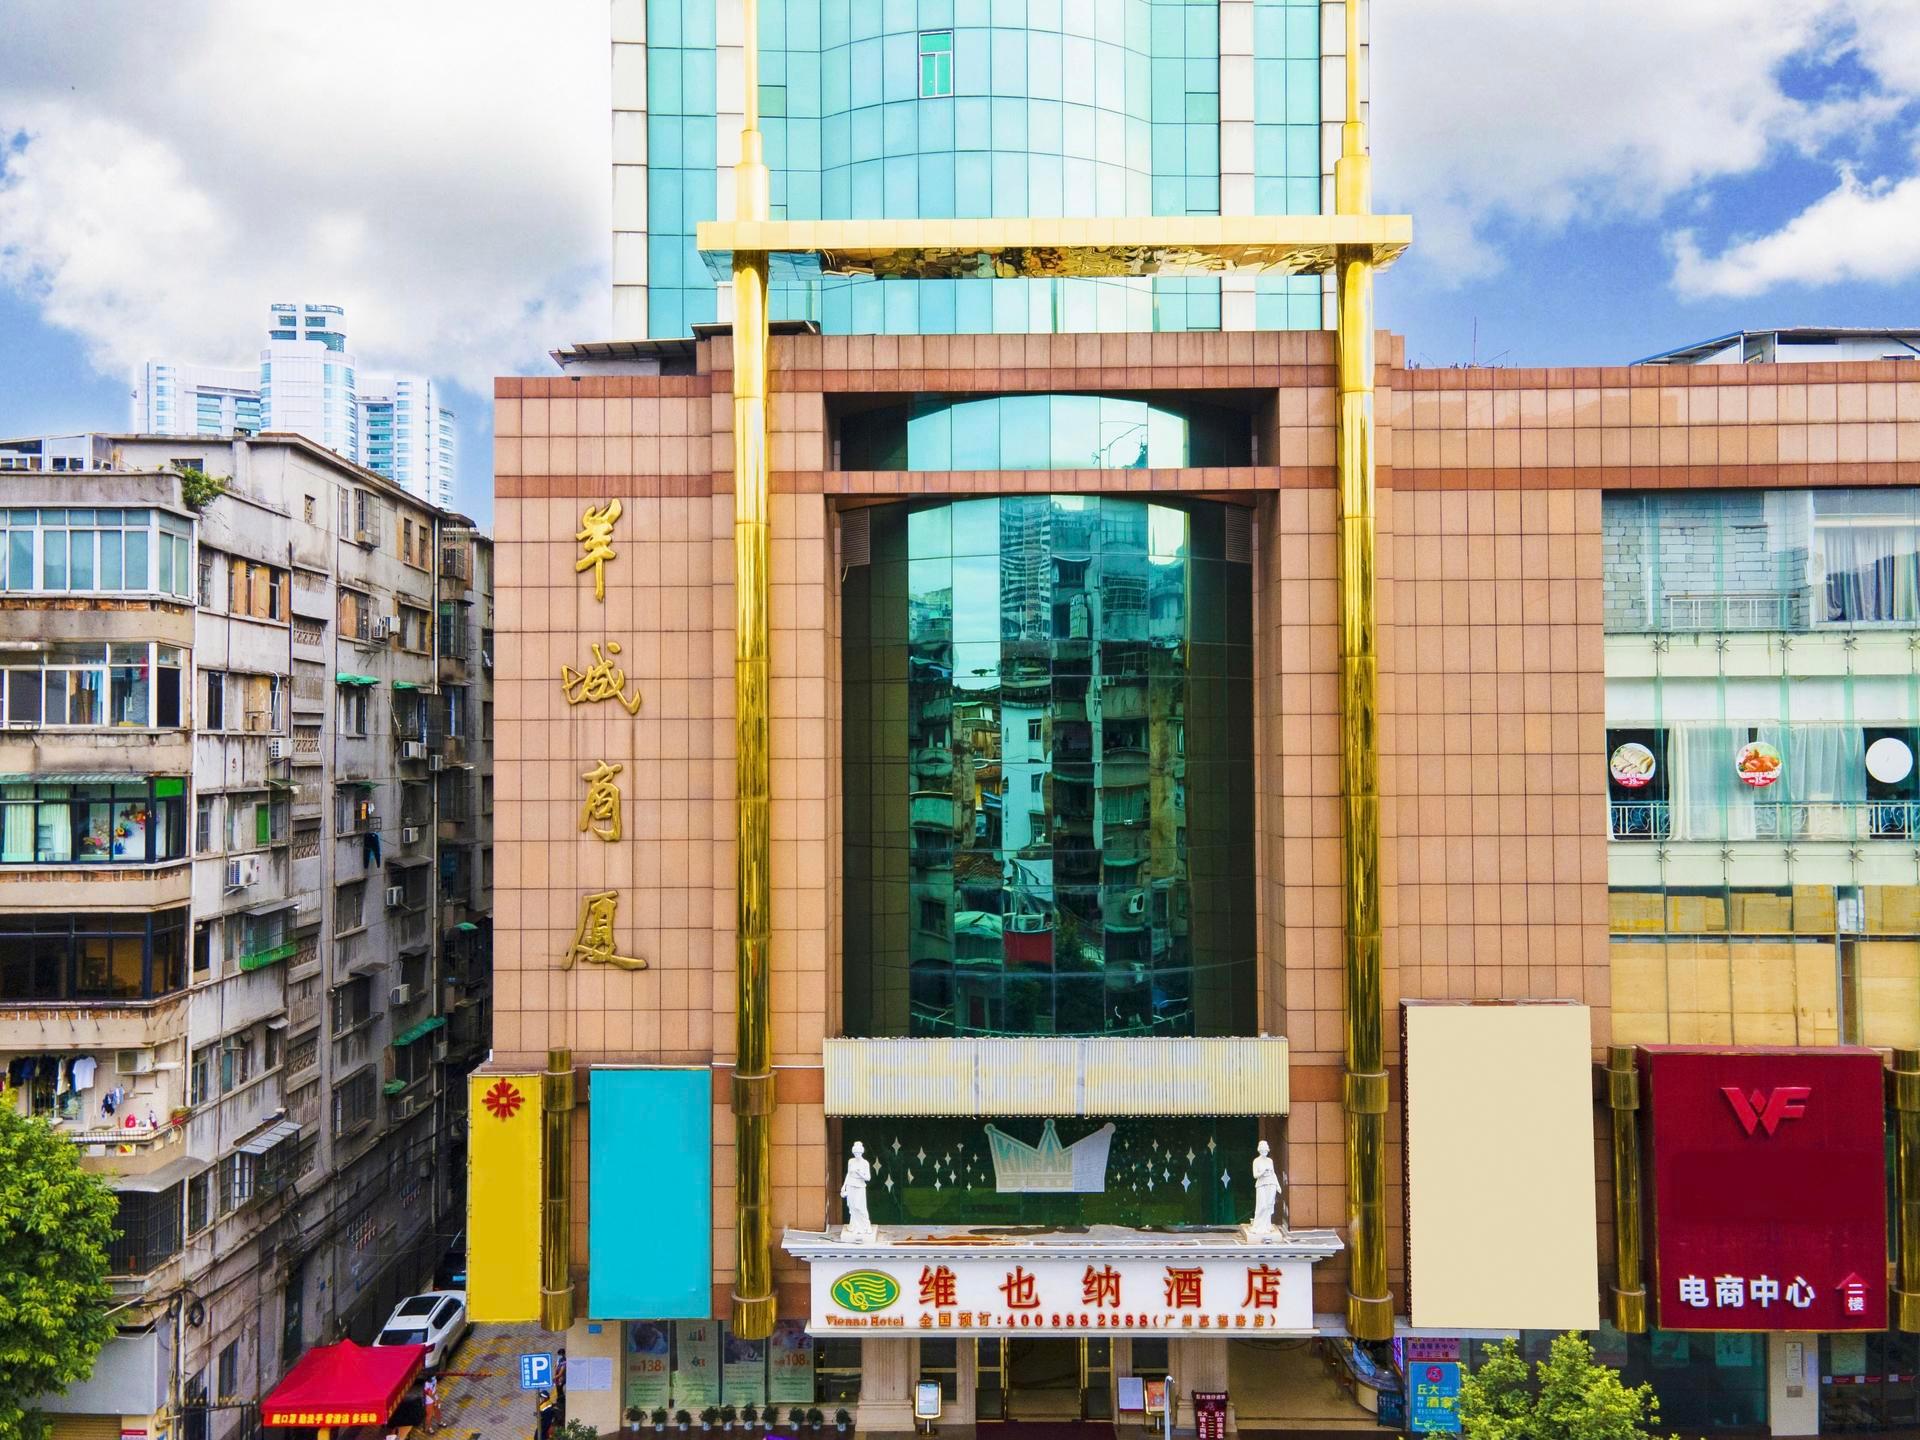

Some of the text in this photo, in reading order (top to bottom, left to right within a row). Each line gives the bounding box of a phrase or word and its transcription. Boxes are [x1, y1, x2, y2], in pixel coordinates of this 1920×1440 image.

[918, 1264, 1283, 1309] 维也纳酒店
[1678, 1274, 1816, 1309] 电商中心
[1847, 1283, 1865, 1312] 二楼
[826, 1315, 904, 1327] Vienna Hotel
[532, 1357, 548, 1380] P
